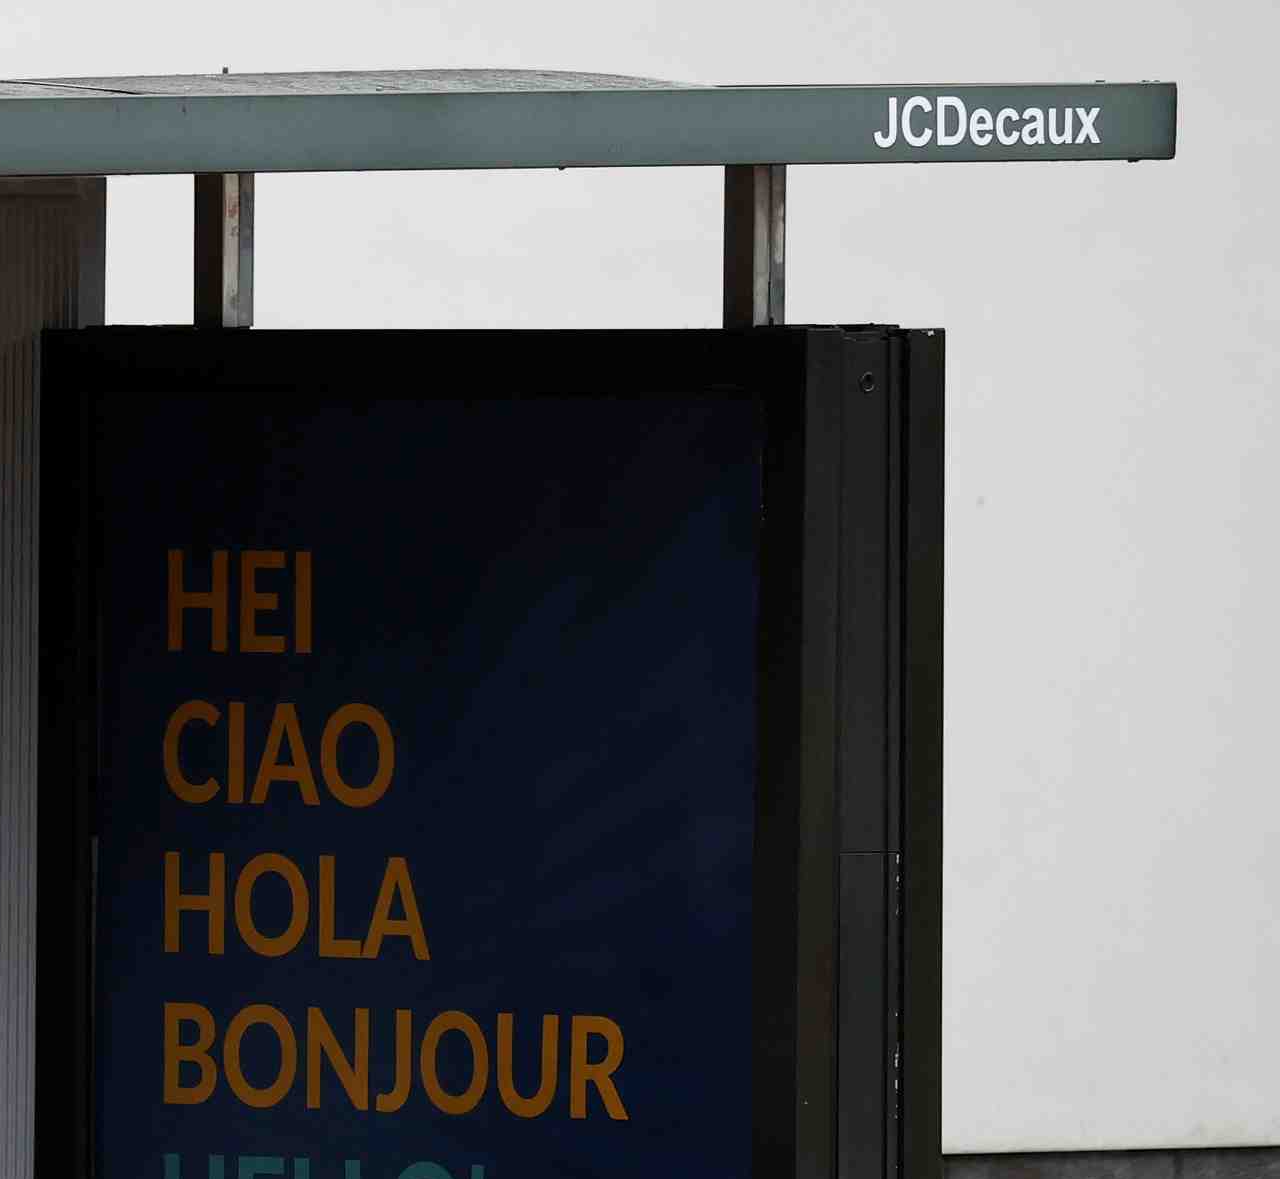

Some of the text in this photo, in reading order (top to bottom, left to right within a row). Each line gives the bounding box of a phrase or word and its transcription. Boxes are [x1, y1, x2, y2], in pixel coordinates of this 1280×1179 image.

[873, 95, 1101, 148] JCDecaux
[167, 549, 312, 654] HEI
[163, 700, 395, 808] CIAO
[164, 851, 431, 960] HOLA
[164, 1002, 629, 1120] BONJOUR
